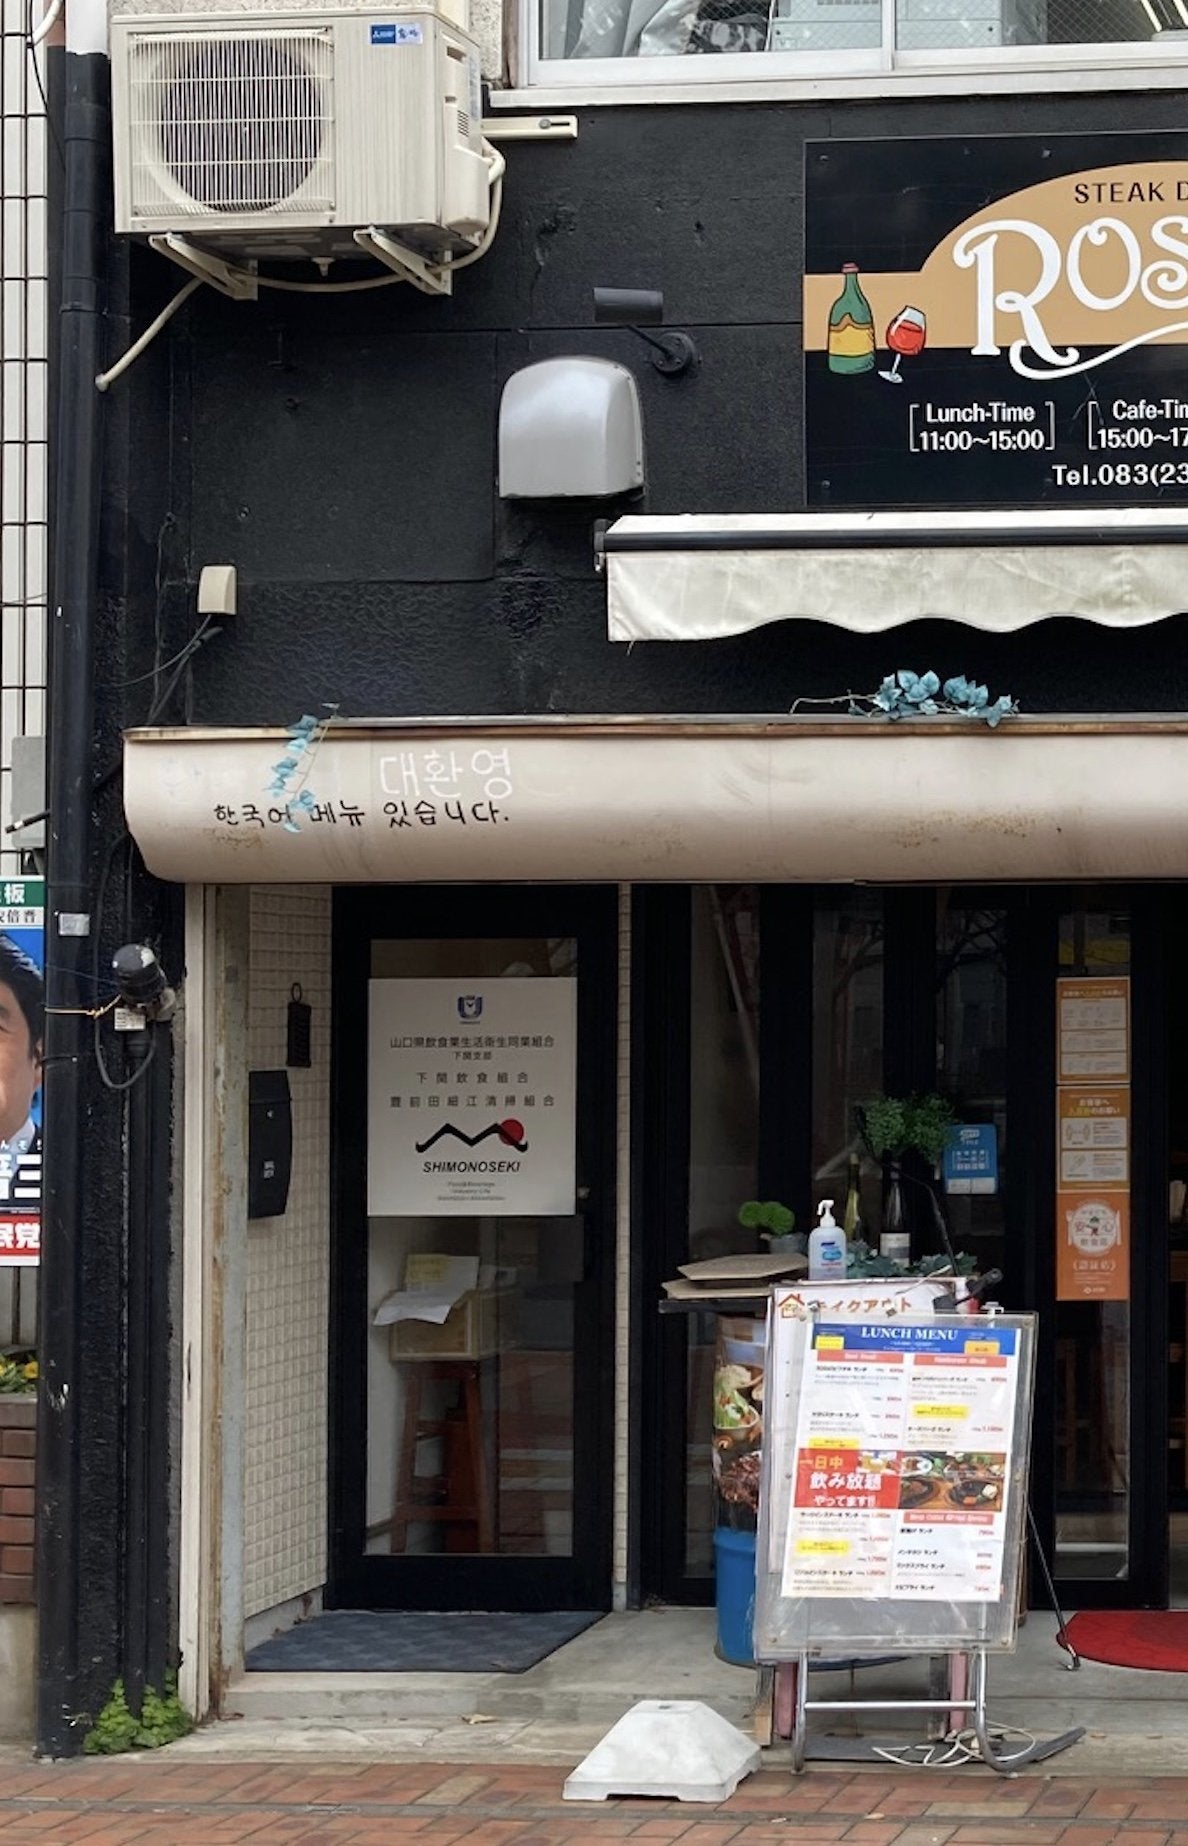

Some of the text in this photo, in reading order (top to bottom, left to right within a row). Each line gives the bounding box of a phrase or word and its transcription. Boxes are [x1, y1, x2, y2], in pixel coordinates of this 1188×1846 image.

[1074, 181, 1165, 204] STEAK
[926, 402, 1035, 424] Lunch-Time
[214, 799, 510, 829] 한국어 메뉴 있습니다.
[0, 883, 25, 905] 板
[422, 1160, 521, 1173] SHIMONOSEKI
[861, 1325, 911, 1339] LUNCH
[915, 1327, 959, 1341] MENU
[810, 1472, 882, 1492] 飲み放題
